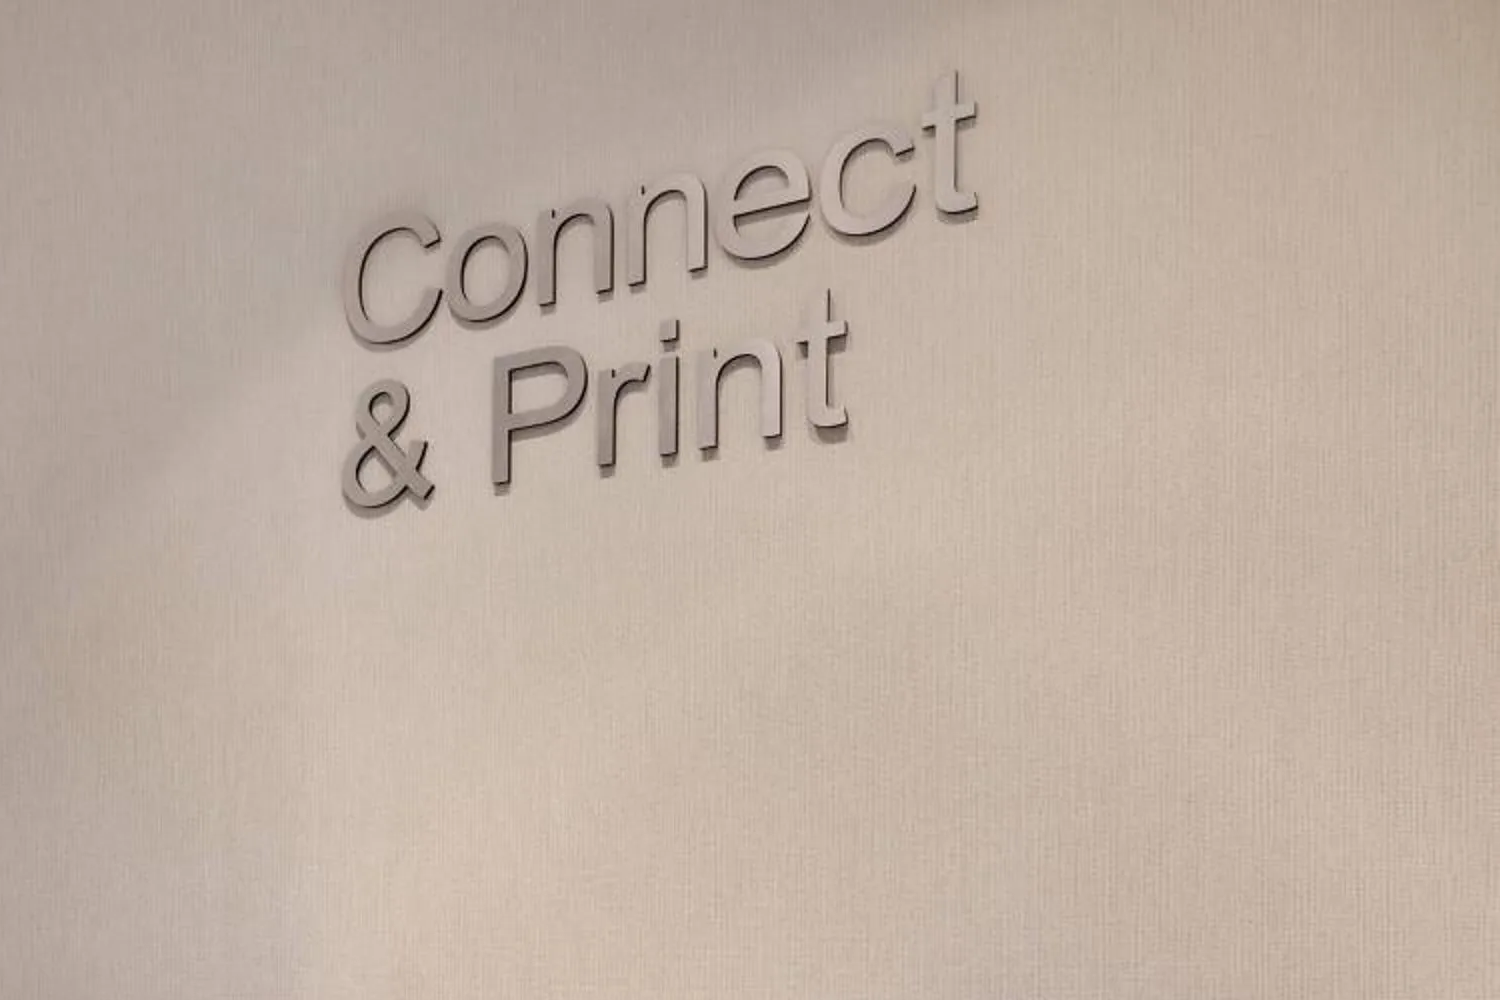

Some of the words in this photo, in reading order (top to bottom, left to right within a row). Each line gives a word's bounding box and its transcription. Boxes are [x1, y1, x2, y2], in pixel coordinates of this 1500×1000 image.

[344, 69, 978, 348] Connect
[342, 379, 435, 510] &
[491, 286, 850, 489] Print
